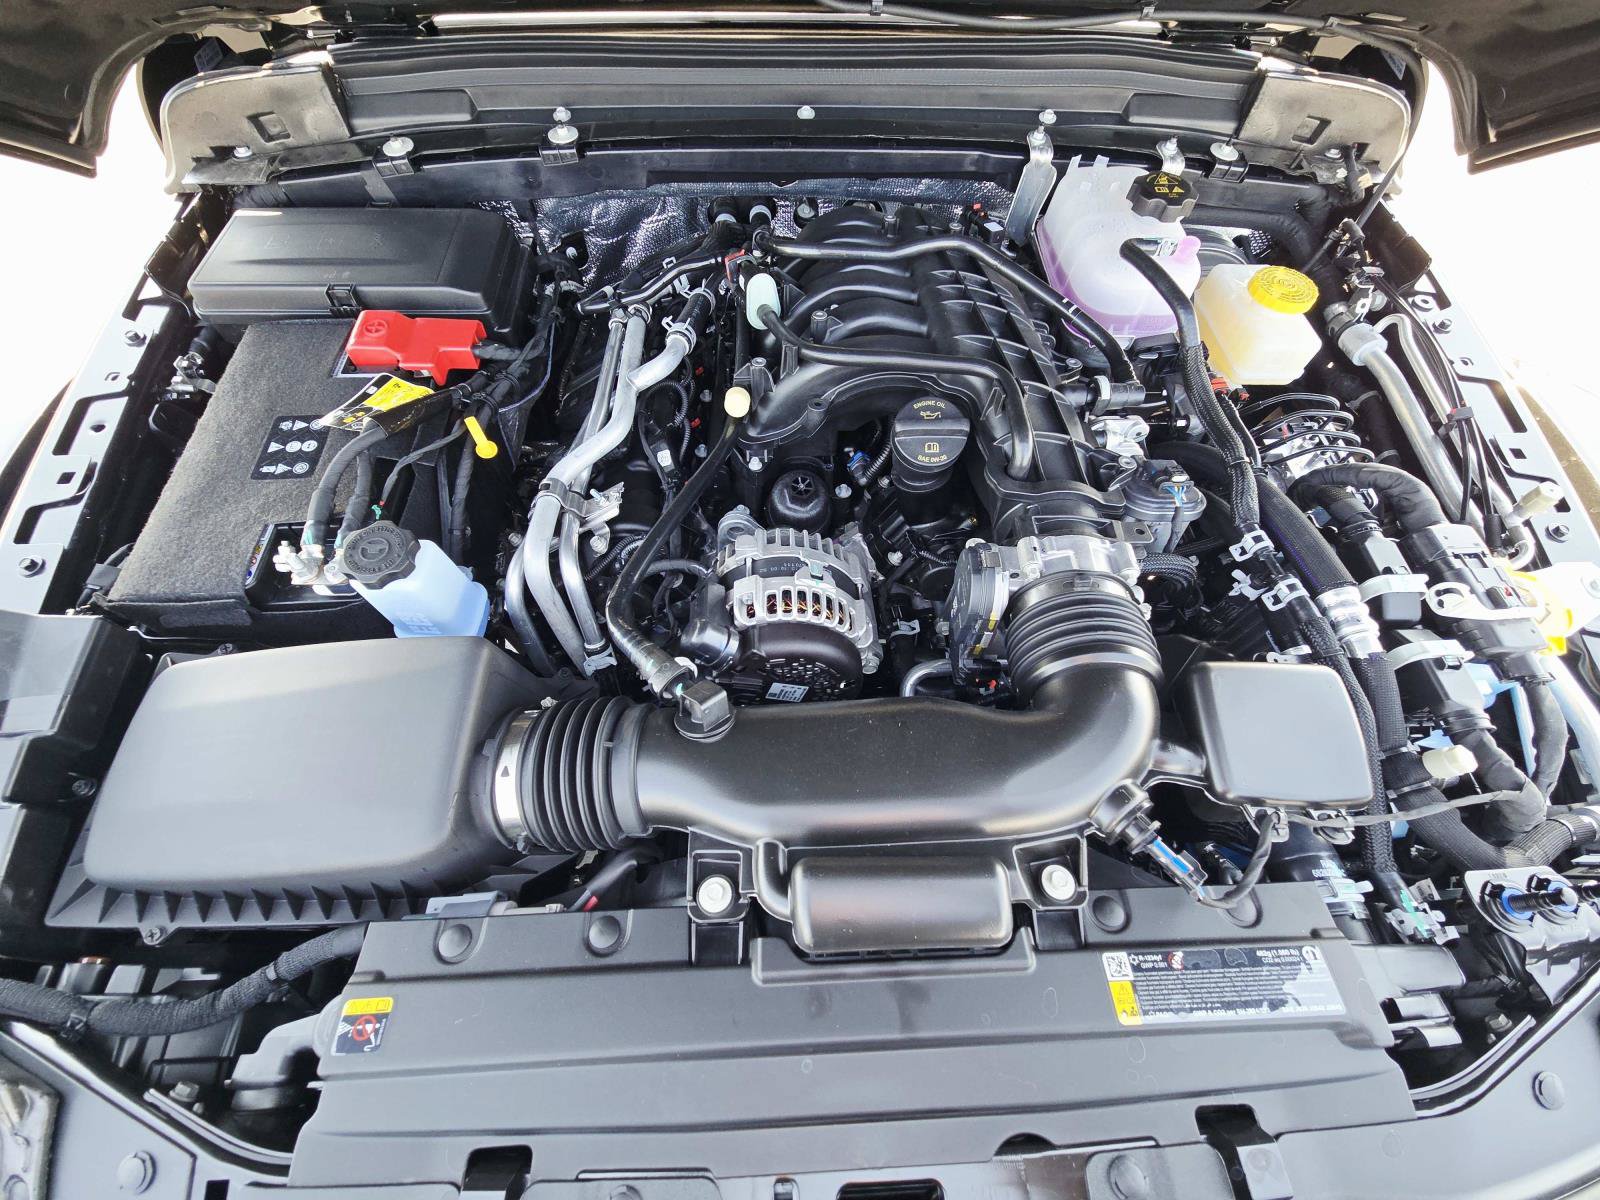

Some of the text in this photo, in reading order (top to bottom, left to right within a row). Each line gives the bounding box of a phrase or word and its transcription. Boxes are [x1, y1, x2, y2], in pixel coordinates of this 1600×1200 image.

[913, 400, 946, 409] ENGINE OIL
[917, 454, 930, 462] SAE
